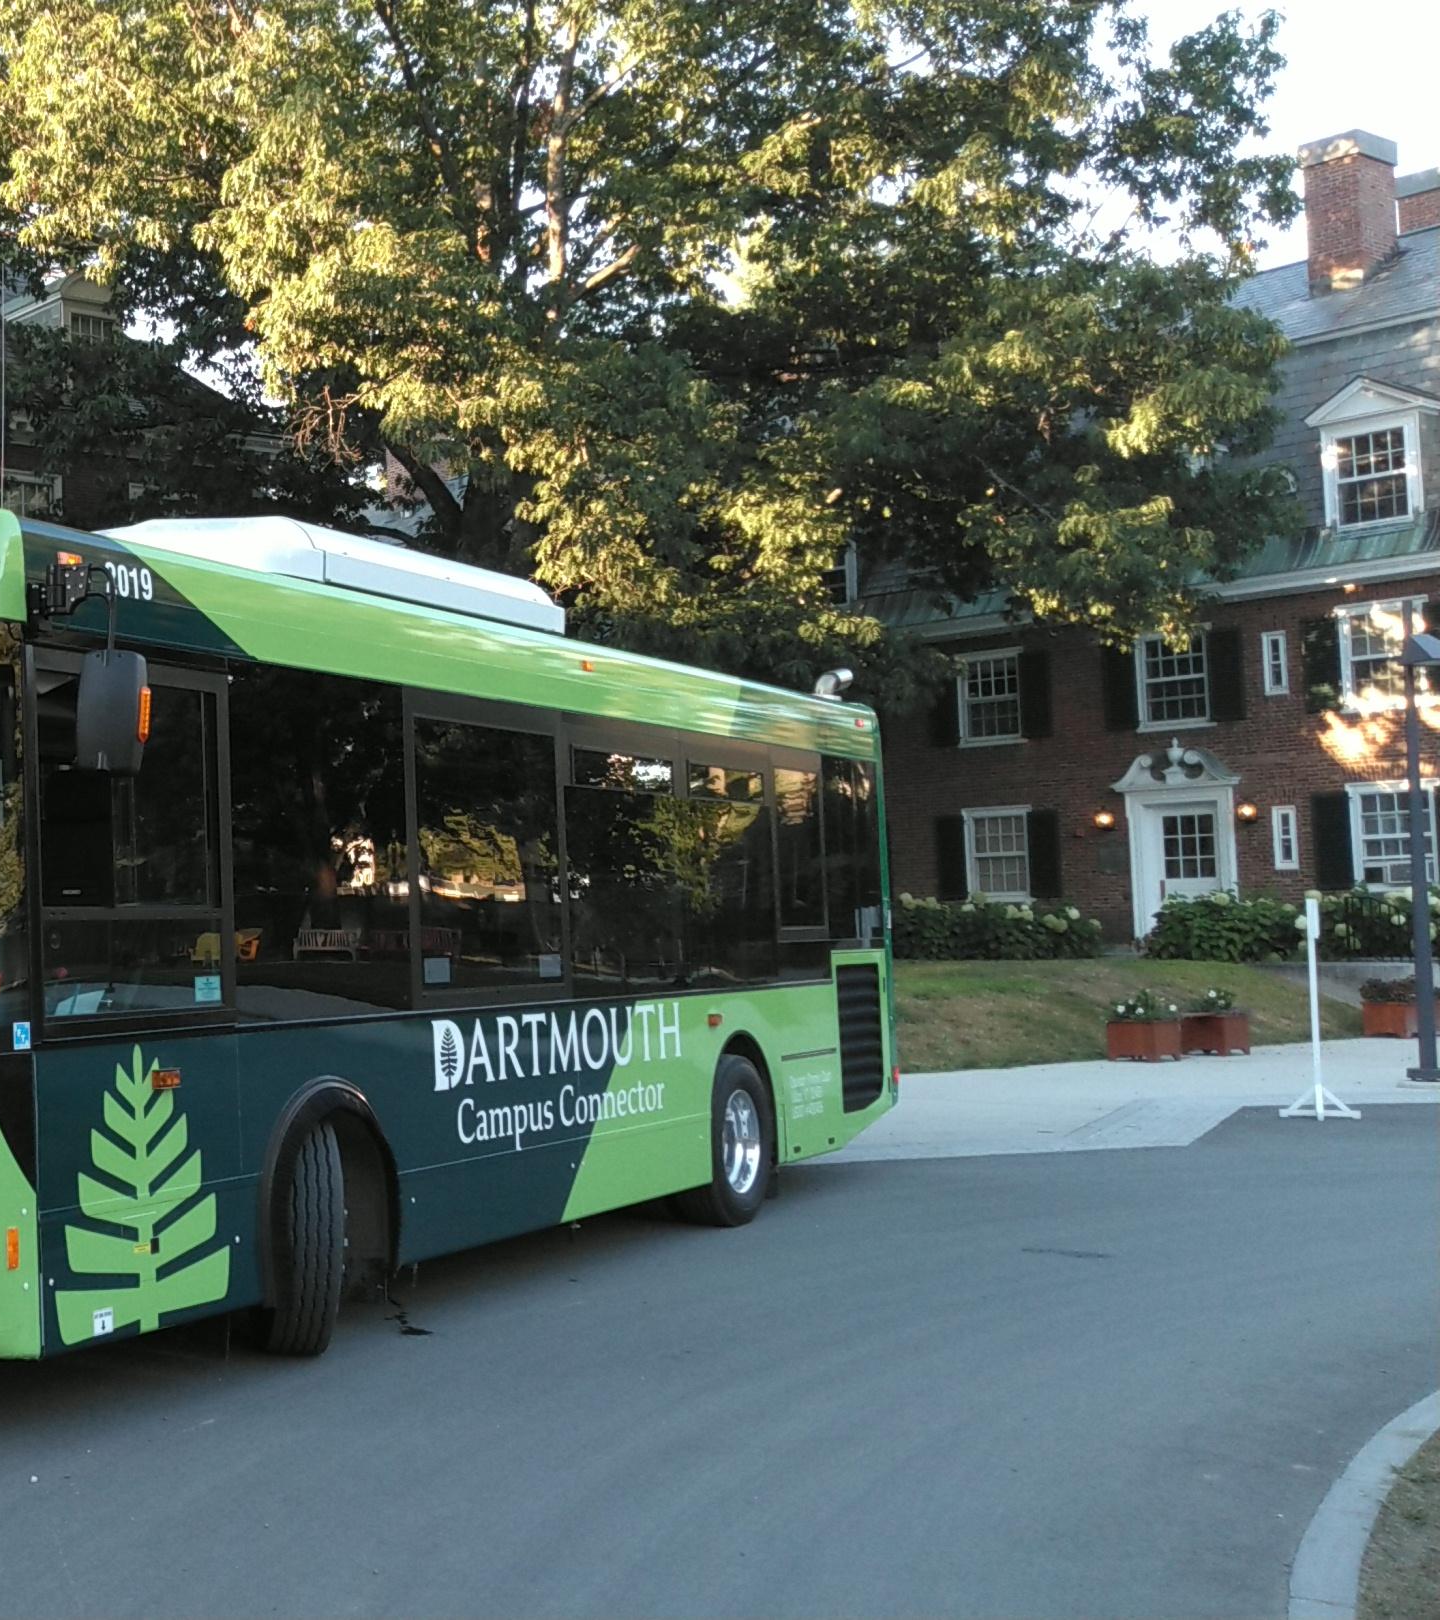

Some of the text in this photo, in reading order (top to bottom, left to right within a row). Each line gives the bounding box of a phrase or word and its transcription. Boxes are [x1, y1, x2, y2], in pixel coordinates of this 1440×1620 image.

[431, 1002, 682, 1091] DARTMOUTH
[457, 1080, 665, 1151] Campus Connector
